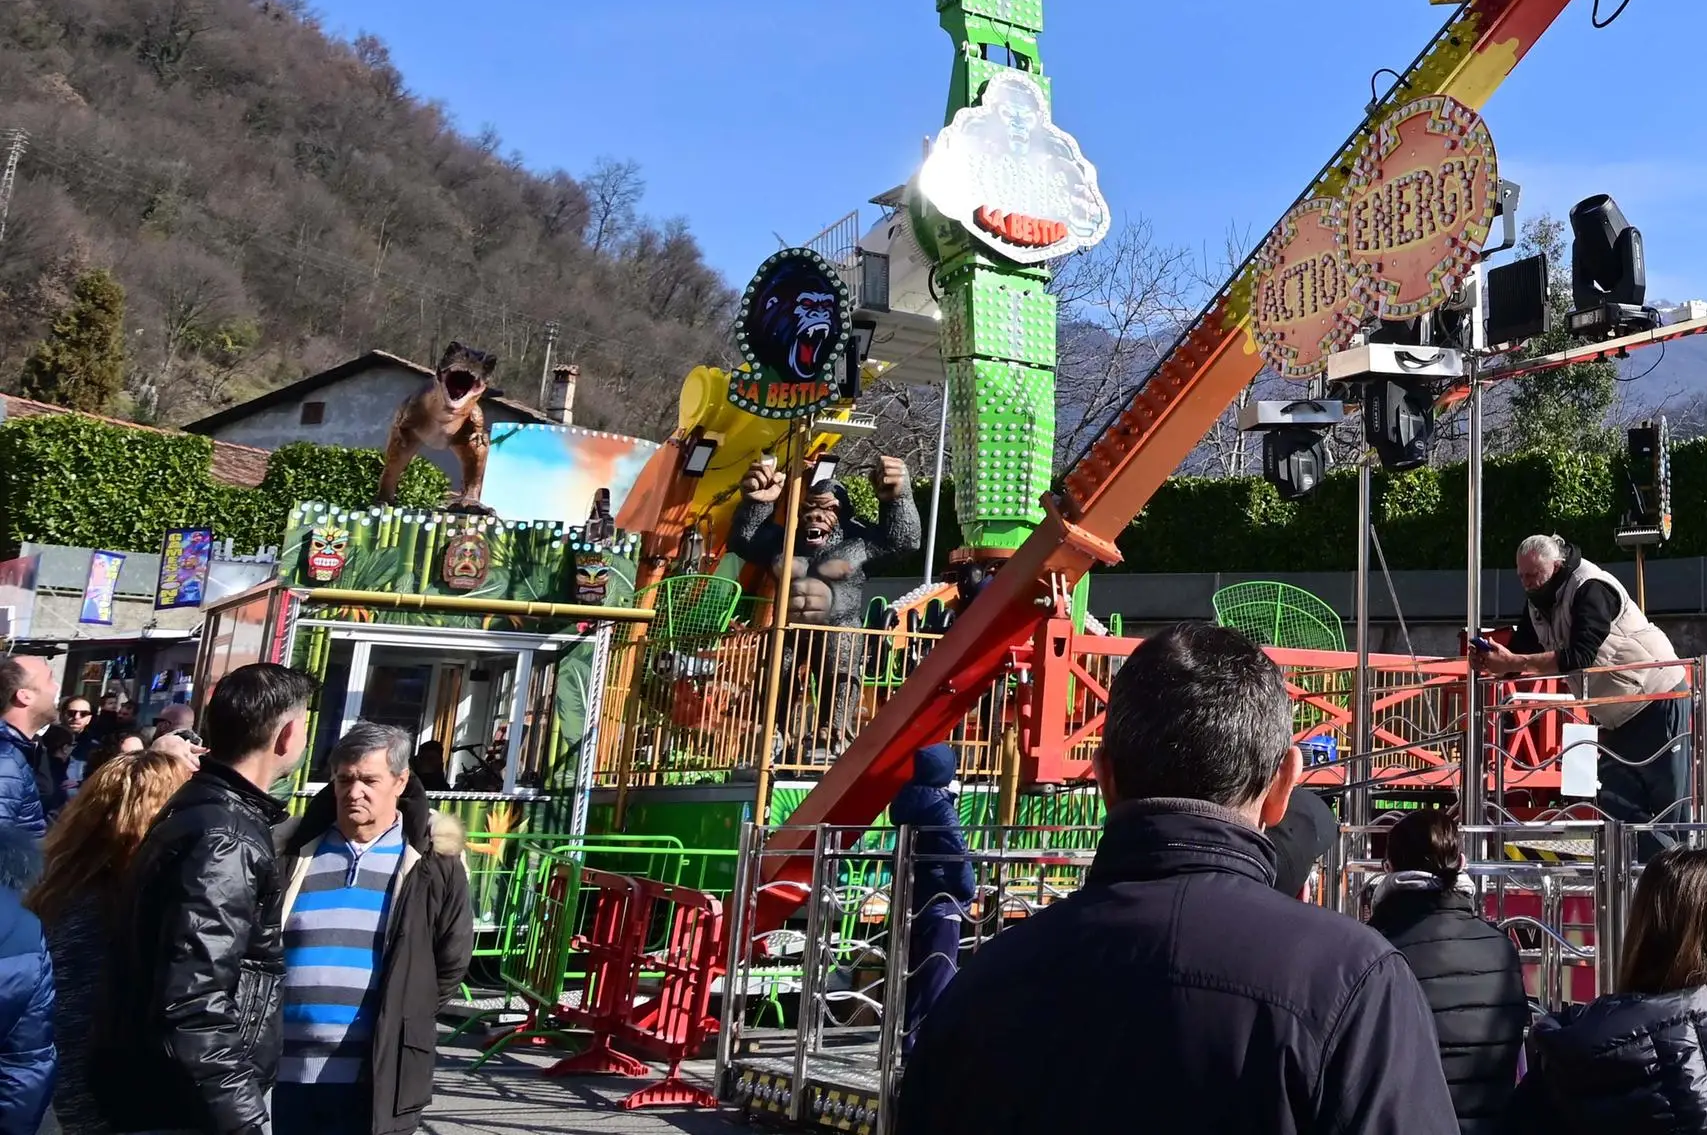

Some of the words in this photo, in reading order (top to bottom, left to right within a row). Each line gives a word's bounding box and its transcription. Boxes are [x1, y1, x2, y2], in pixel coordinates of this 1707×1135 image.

[1350, 157, 1482, 253] ENERGY
[1007, 213, 1069, 246] BESTIA
[737, 380, 760, 404] LA
[765, 382, 830, 409] BESTIA
